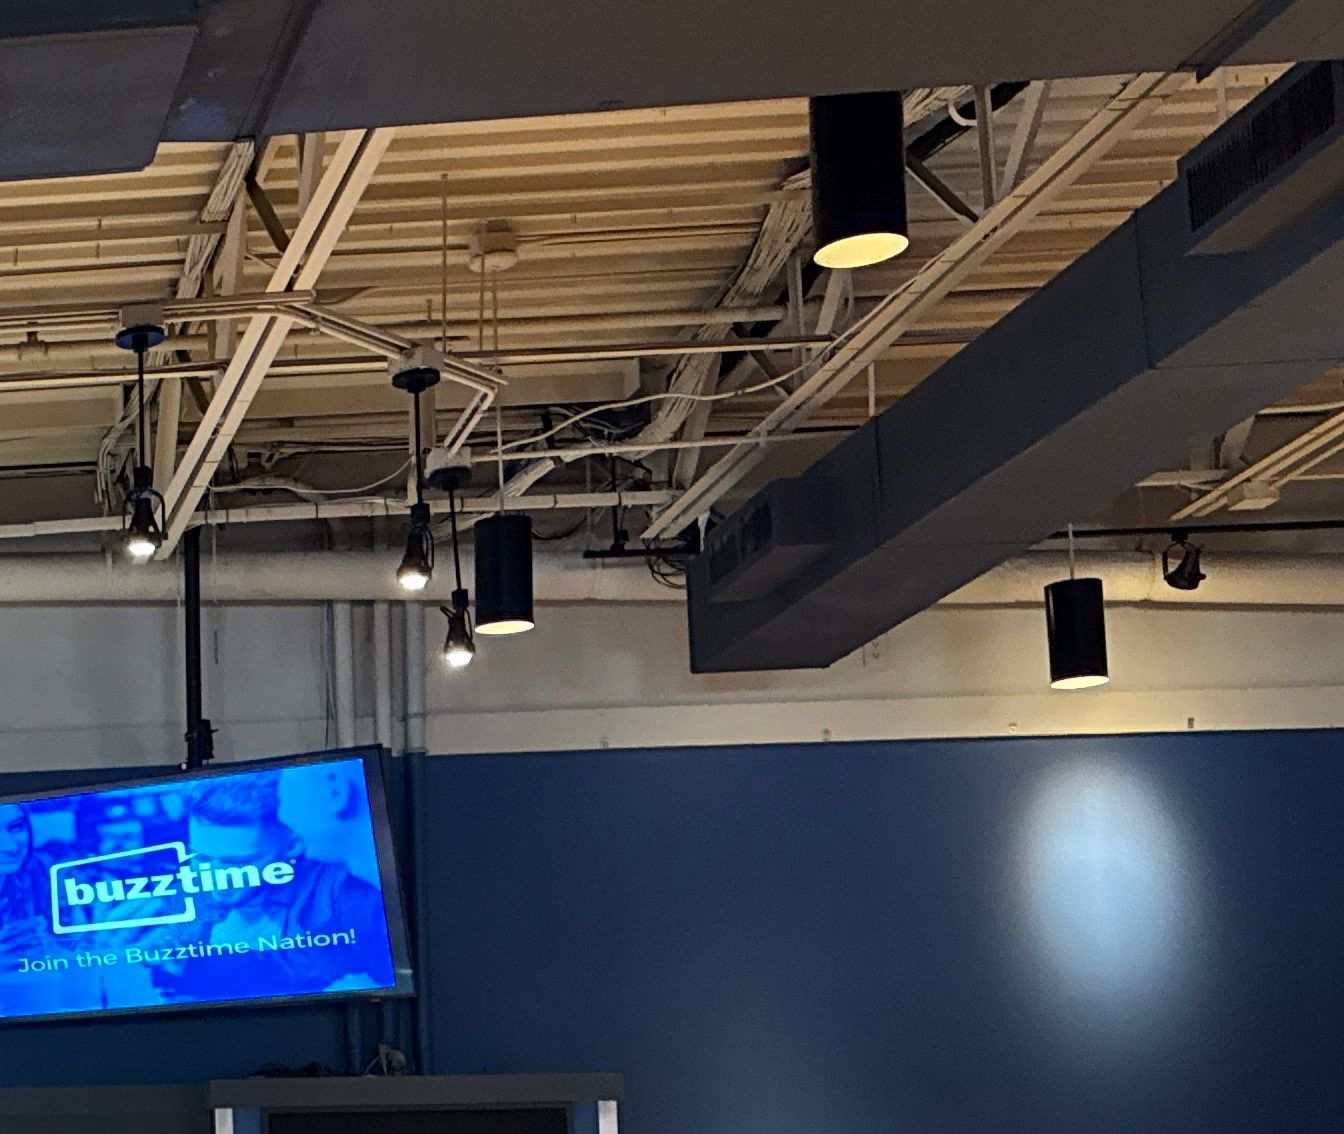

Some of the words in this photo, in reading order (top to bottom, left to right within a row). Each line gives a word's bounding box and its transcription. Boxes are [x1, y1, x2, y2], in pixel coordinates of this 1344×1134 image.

[65, 859, 296, 906] buzztime
[17, 956, 69, 974] Join
[76, 950, 118, 969] the
[126, 937, 250, 965] Buzztime
[257, 928, 357, 953] Nation!
